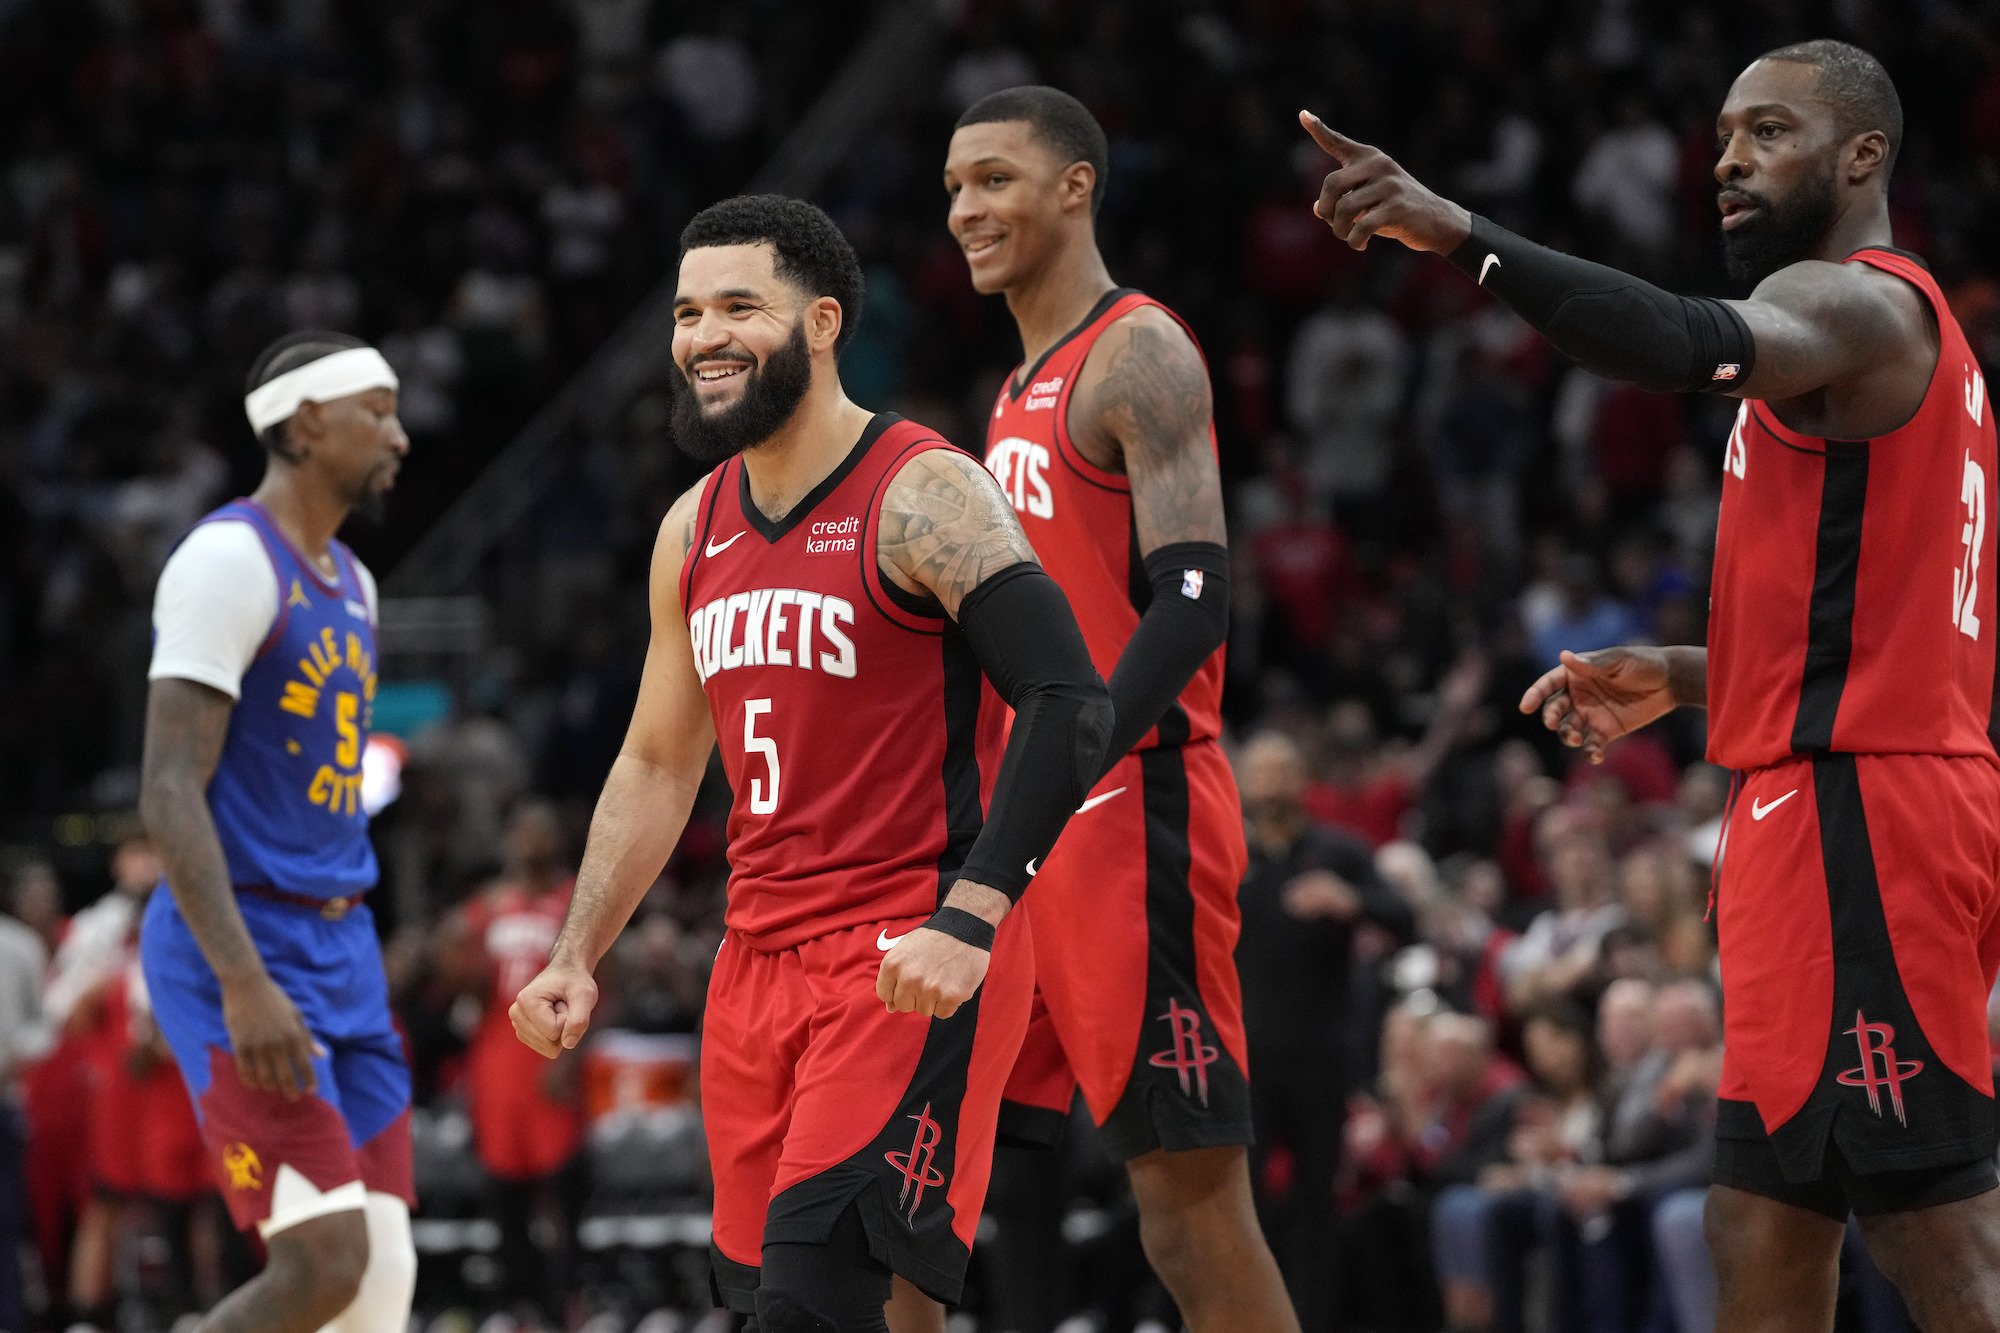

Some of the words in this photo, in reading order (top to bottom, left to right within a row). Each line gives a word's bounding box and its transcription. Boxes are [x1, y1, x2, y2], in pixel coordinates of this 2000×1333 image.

[806, 536, 855, 553] karma
[811, 516, 859, 535] credit
[279, 627, 343, 719] MILE
[690, 588, 857, 685] ROCKETS
[336, 691, 360, 768] 5
[744, 698, 780, 815] 5
